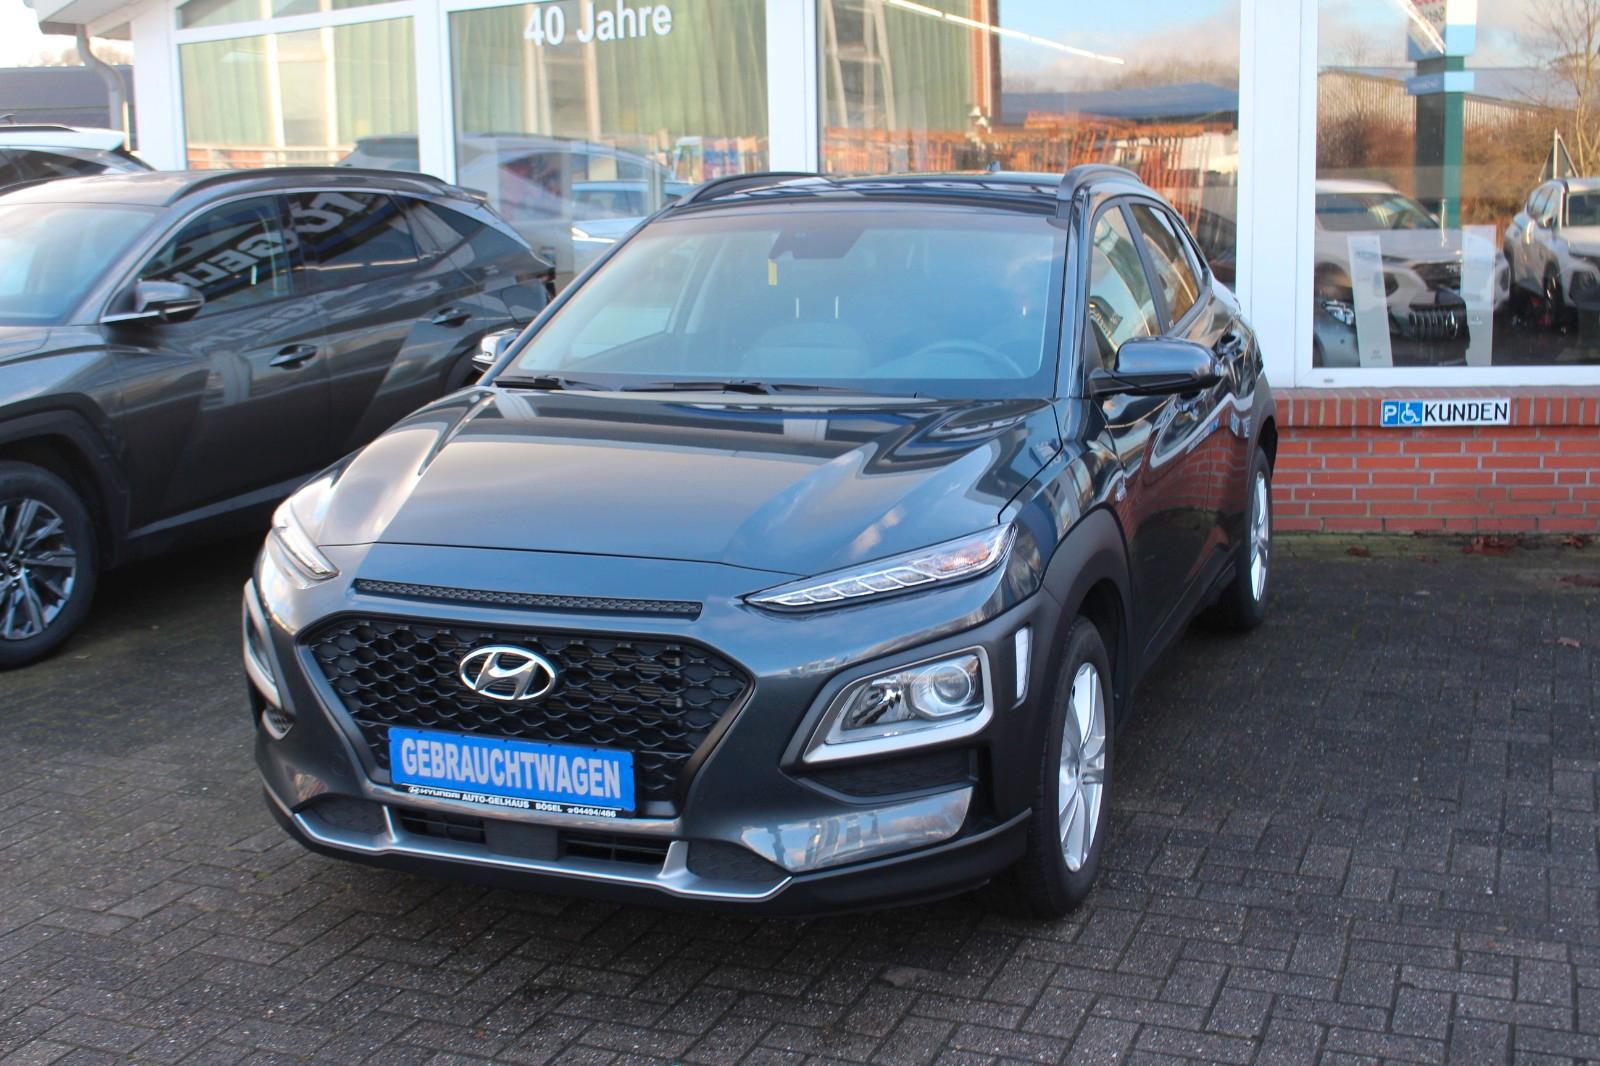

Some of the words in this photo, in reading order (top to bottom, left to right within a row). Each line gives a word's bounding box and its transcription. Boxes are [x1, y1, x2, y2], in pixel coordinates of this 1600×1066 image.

[523, 6, 565, 46] 40
[576, 0, 673, 43] Jahre
[1384, 405, 1397, 422] P
[1424, 402, 1508, 422] KUNDEN
[401, 737, 621, 799] GEBRAUCHTWAGEN
[461, 793, 530, 809] AUTO-GELHAUS
